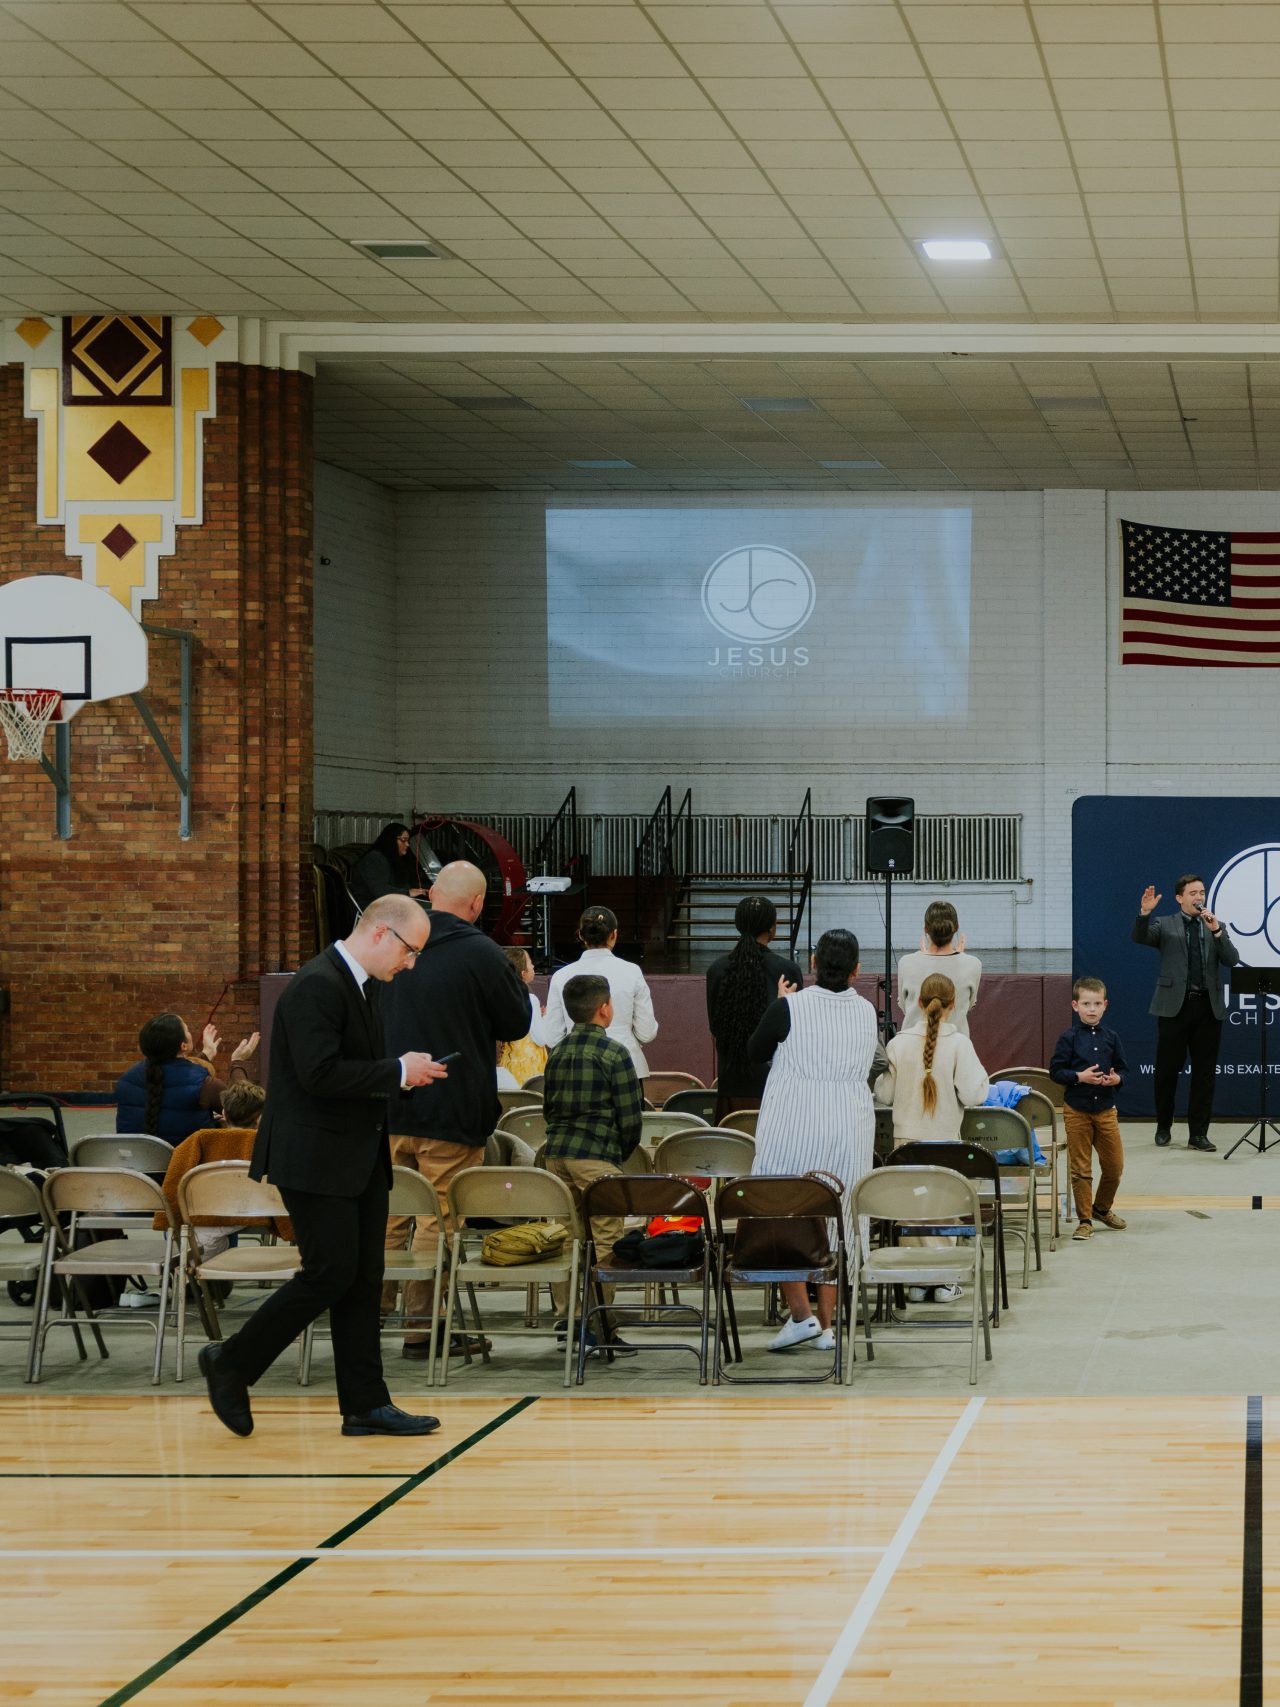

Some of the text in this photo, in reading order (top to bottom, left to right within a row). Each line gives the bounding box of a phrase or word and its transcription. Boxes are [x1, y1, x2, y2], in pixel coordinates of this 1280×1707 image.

[707, 647, 810, 666] JESUS
[719, 666, 797, 678] CHURCH
[1224, 1064, 1235, 1075] IS
